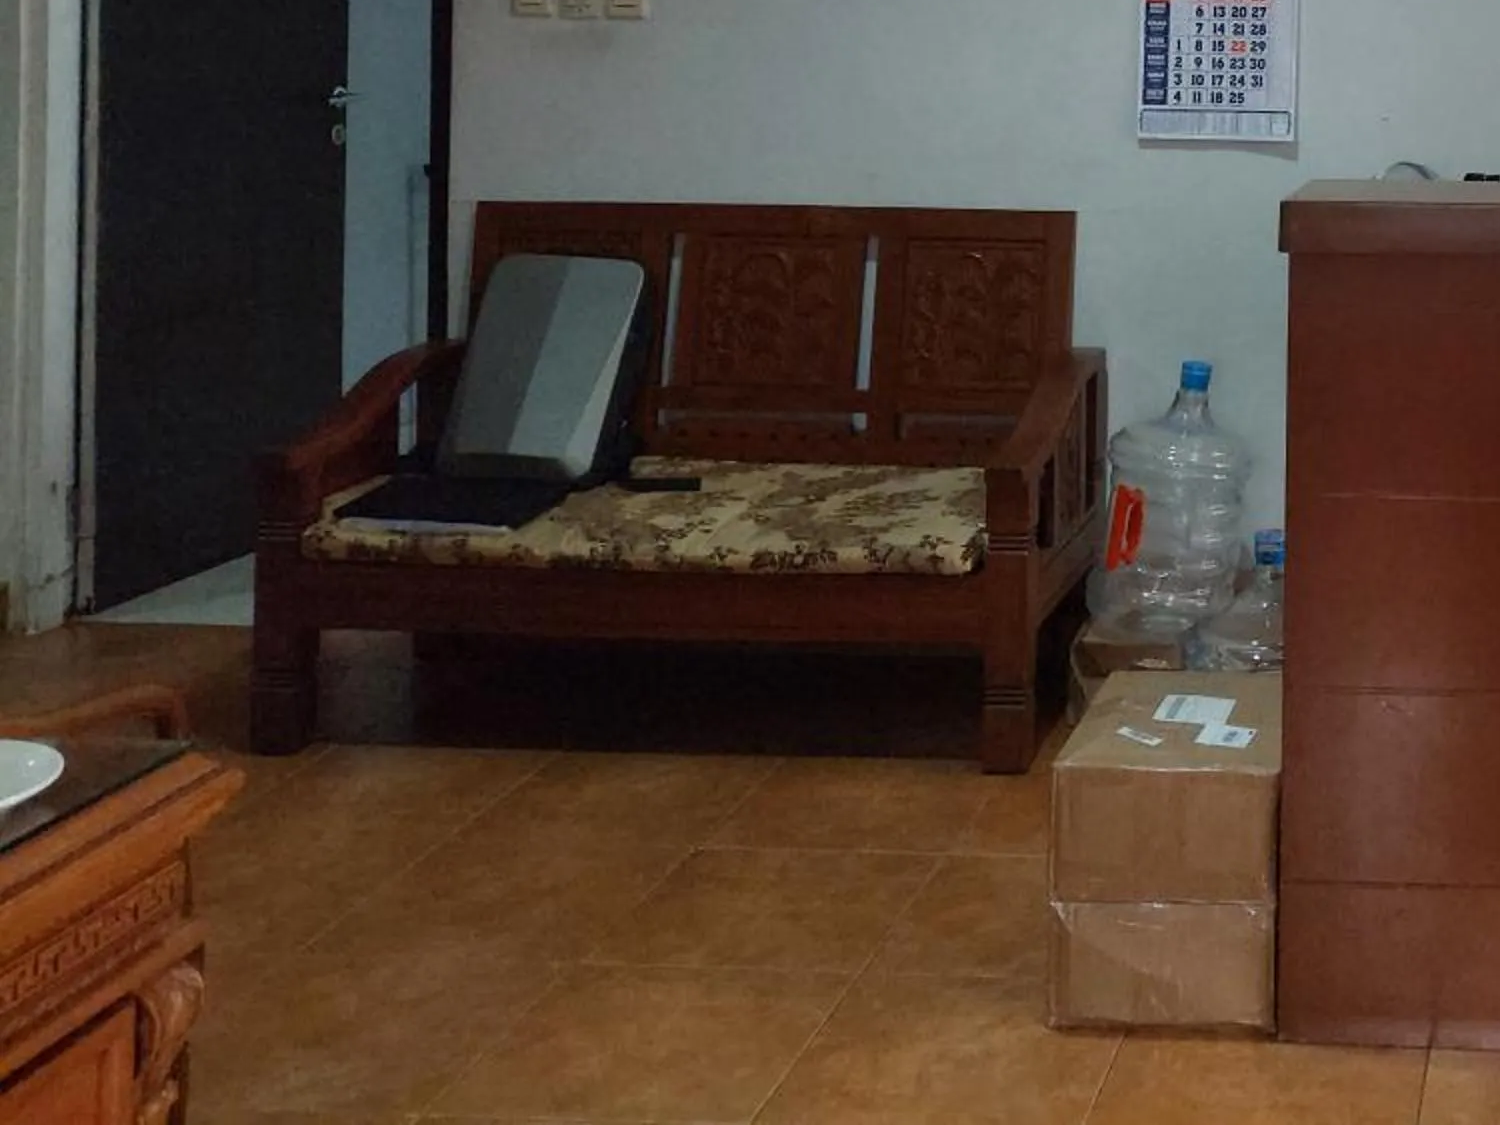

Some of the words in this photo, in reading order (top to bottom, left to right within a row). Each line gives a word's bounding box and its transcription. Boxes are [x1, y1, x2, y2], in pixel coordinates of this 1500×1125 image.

[1195, 7, 1204, 18] 6
[1213, 7, 1226, 18] 13
[1231, 7, 1247, 18] 20
[1251, 7, 1267, 18] 27
[1195, 23, 1203, 34] 7
[1213, 23, 1225, 34] 14
[1232, 23, 1245, 35] 21
[1251, 24, 1267, 35] 28
[1176, 40, 1181, 50] 1
[1195, 40, 1203, 51] 8
[1212, 40, 1225, 51] 15
[1230, 40, 1246, 51] 22
[1250, 40, 1266, 52] 29
[1174, 57, 1183, 68] 2
[1194, 57, 1202, 68] 9
[1211, 57, 1224, 69] 16
[1229, 57, 1246, 69] 23
[1249, 58, 1266, 69] 30
[1173, 74, 1182, 86] 3
[1191, 74, 1204, 85] 10
[1211, 74, 1224, 86] 17
[1229, 75, 1245, 86] 24
[1250, 75, 1263, 86] 31
[1173, 91, 1181, 104] 4
[1192, 91, 1201, 103] 11
[1210, 91, 1223, 103] 18
[1229, 92, 1245, 104] 25
